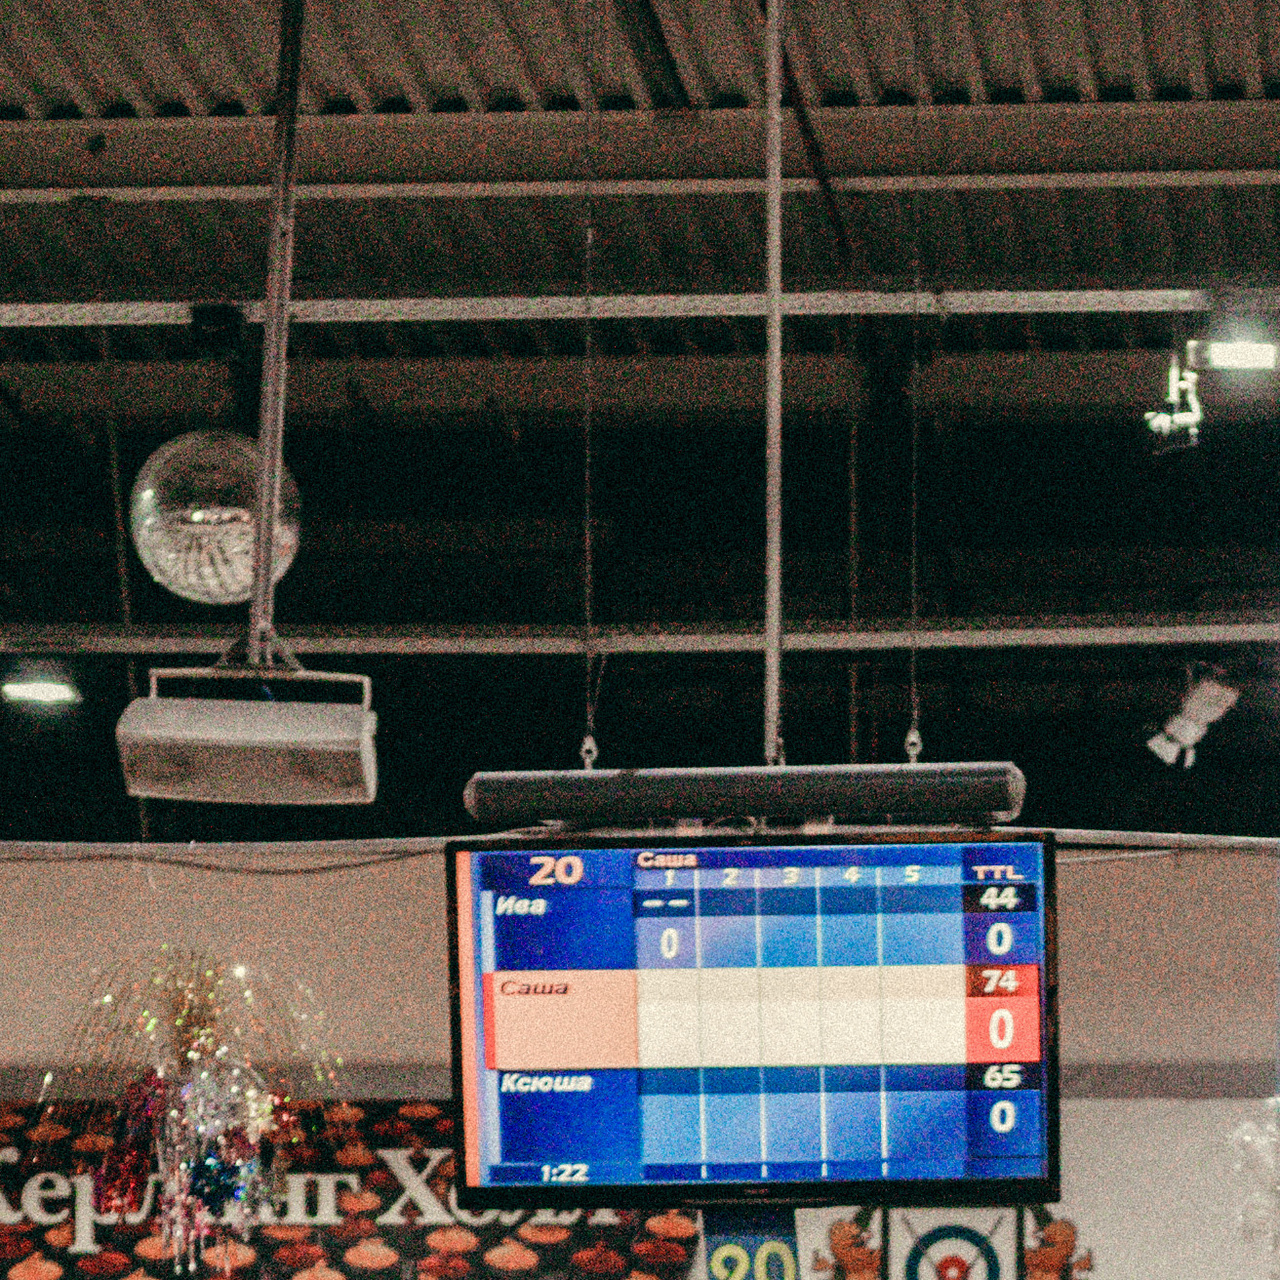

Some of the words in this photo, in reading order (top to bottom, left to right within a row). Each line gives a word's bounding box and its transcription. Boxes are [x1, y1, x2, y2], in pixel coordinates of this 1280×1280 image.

[528, 855, 584, 886] 20
[636, 852, 698, 868] Саша
[664, 870, 676, 886] 1
[722, 868, 741, 886] 2
[783, 867, 800, 885] 3
[843, 866, 861, 884] 4
[905, 865, 921, 883] 5
[972, 865, 1025, 881] TTL
[978, 886, 1020, 909] 44
[660, 927, 679, 960] 0
[986, 921, 1014, 955] 0
[500, 980, 571, 996] Саша
[981, 970, 1020, 993] 74
[988, 1008, 1015, 1050] 0
[500, 1072, 592, 1094] Ксюша
[983, 1064, 1022, 1089] 65
[989, 1101, 1017, 1133] 0
[540, 1164, 590, 1183] 1:22
